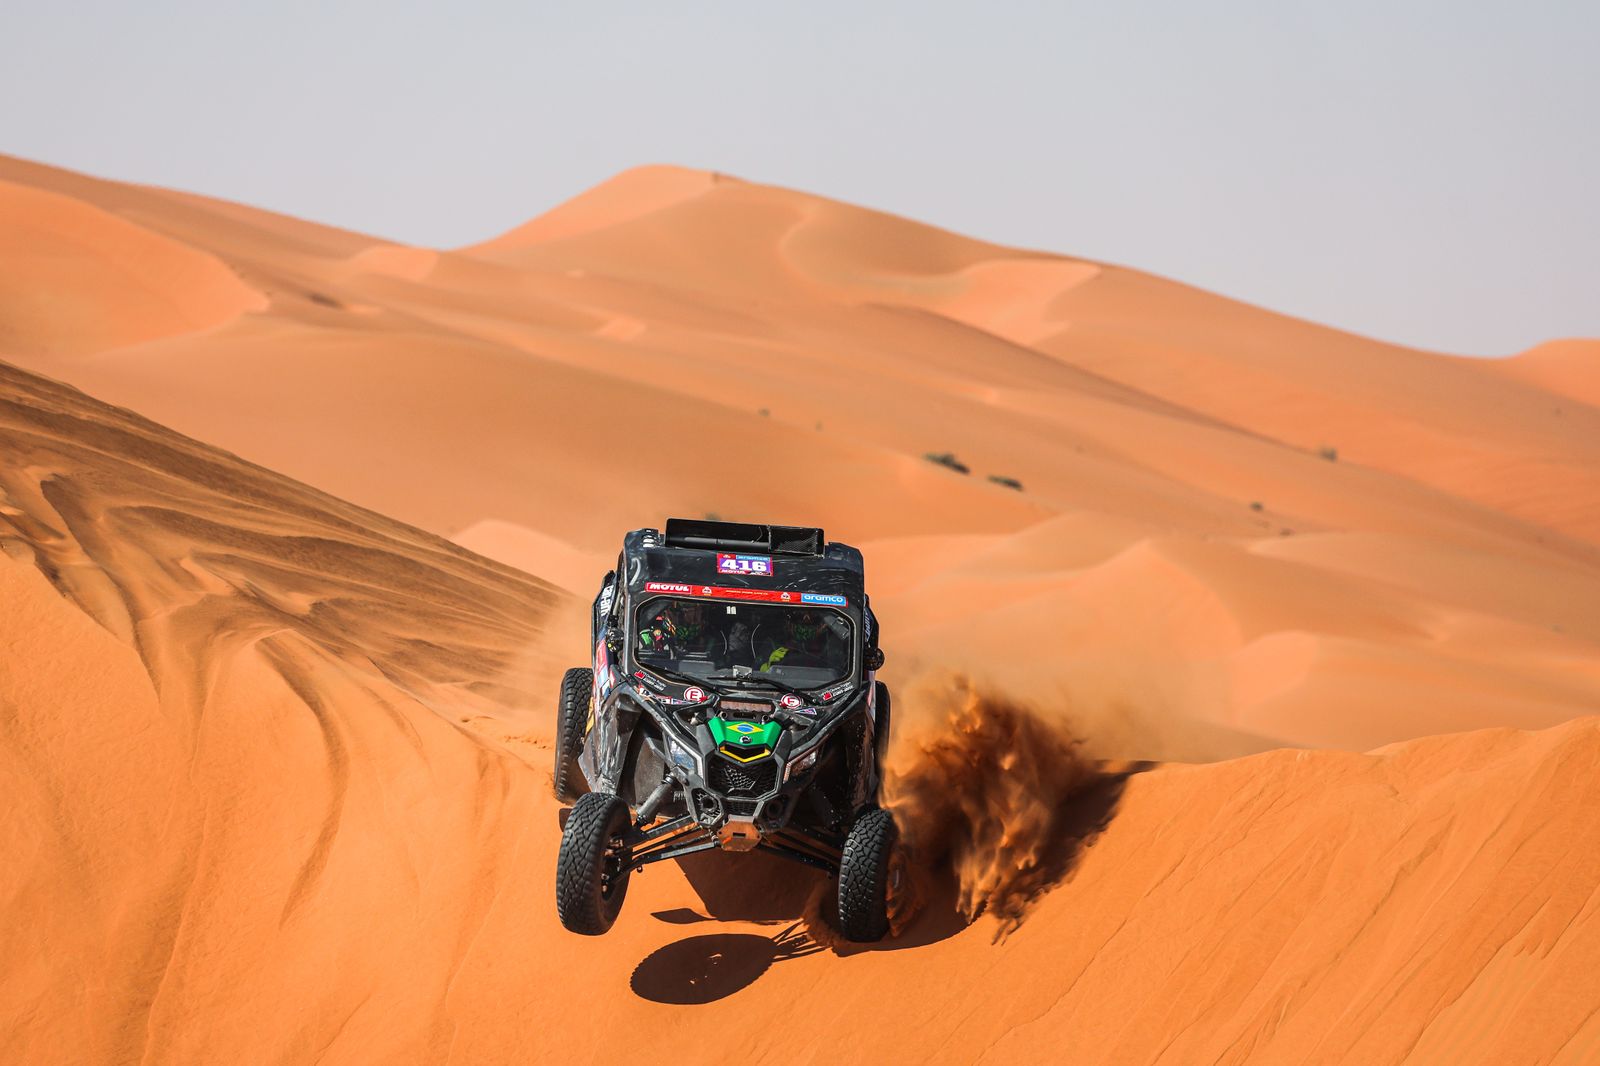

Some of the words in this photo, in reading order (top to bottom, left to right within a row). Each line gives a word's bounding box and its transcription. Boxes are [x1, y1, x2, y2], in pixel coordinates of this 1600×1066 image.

[721, 559, 767, 571] 416
[649, 583, 690, 592] MOTUL
[803, 593, 844, 603] aramco
[690, 690, 699, 702] E
